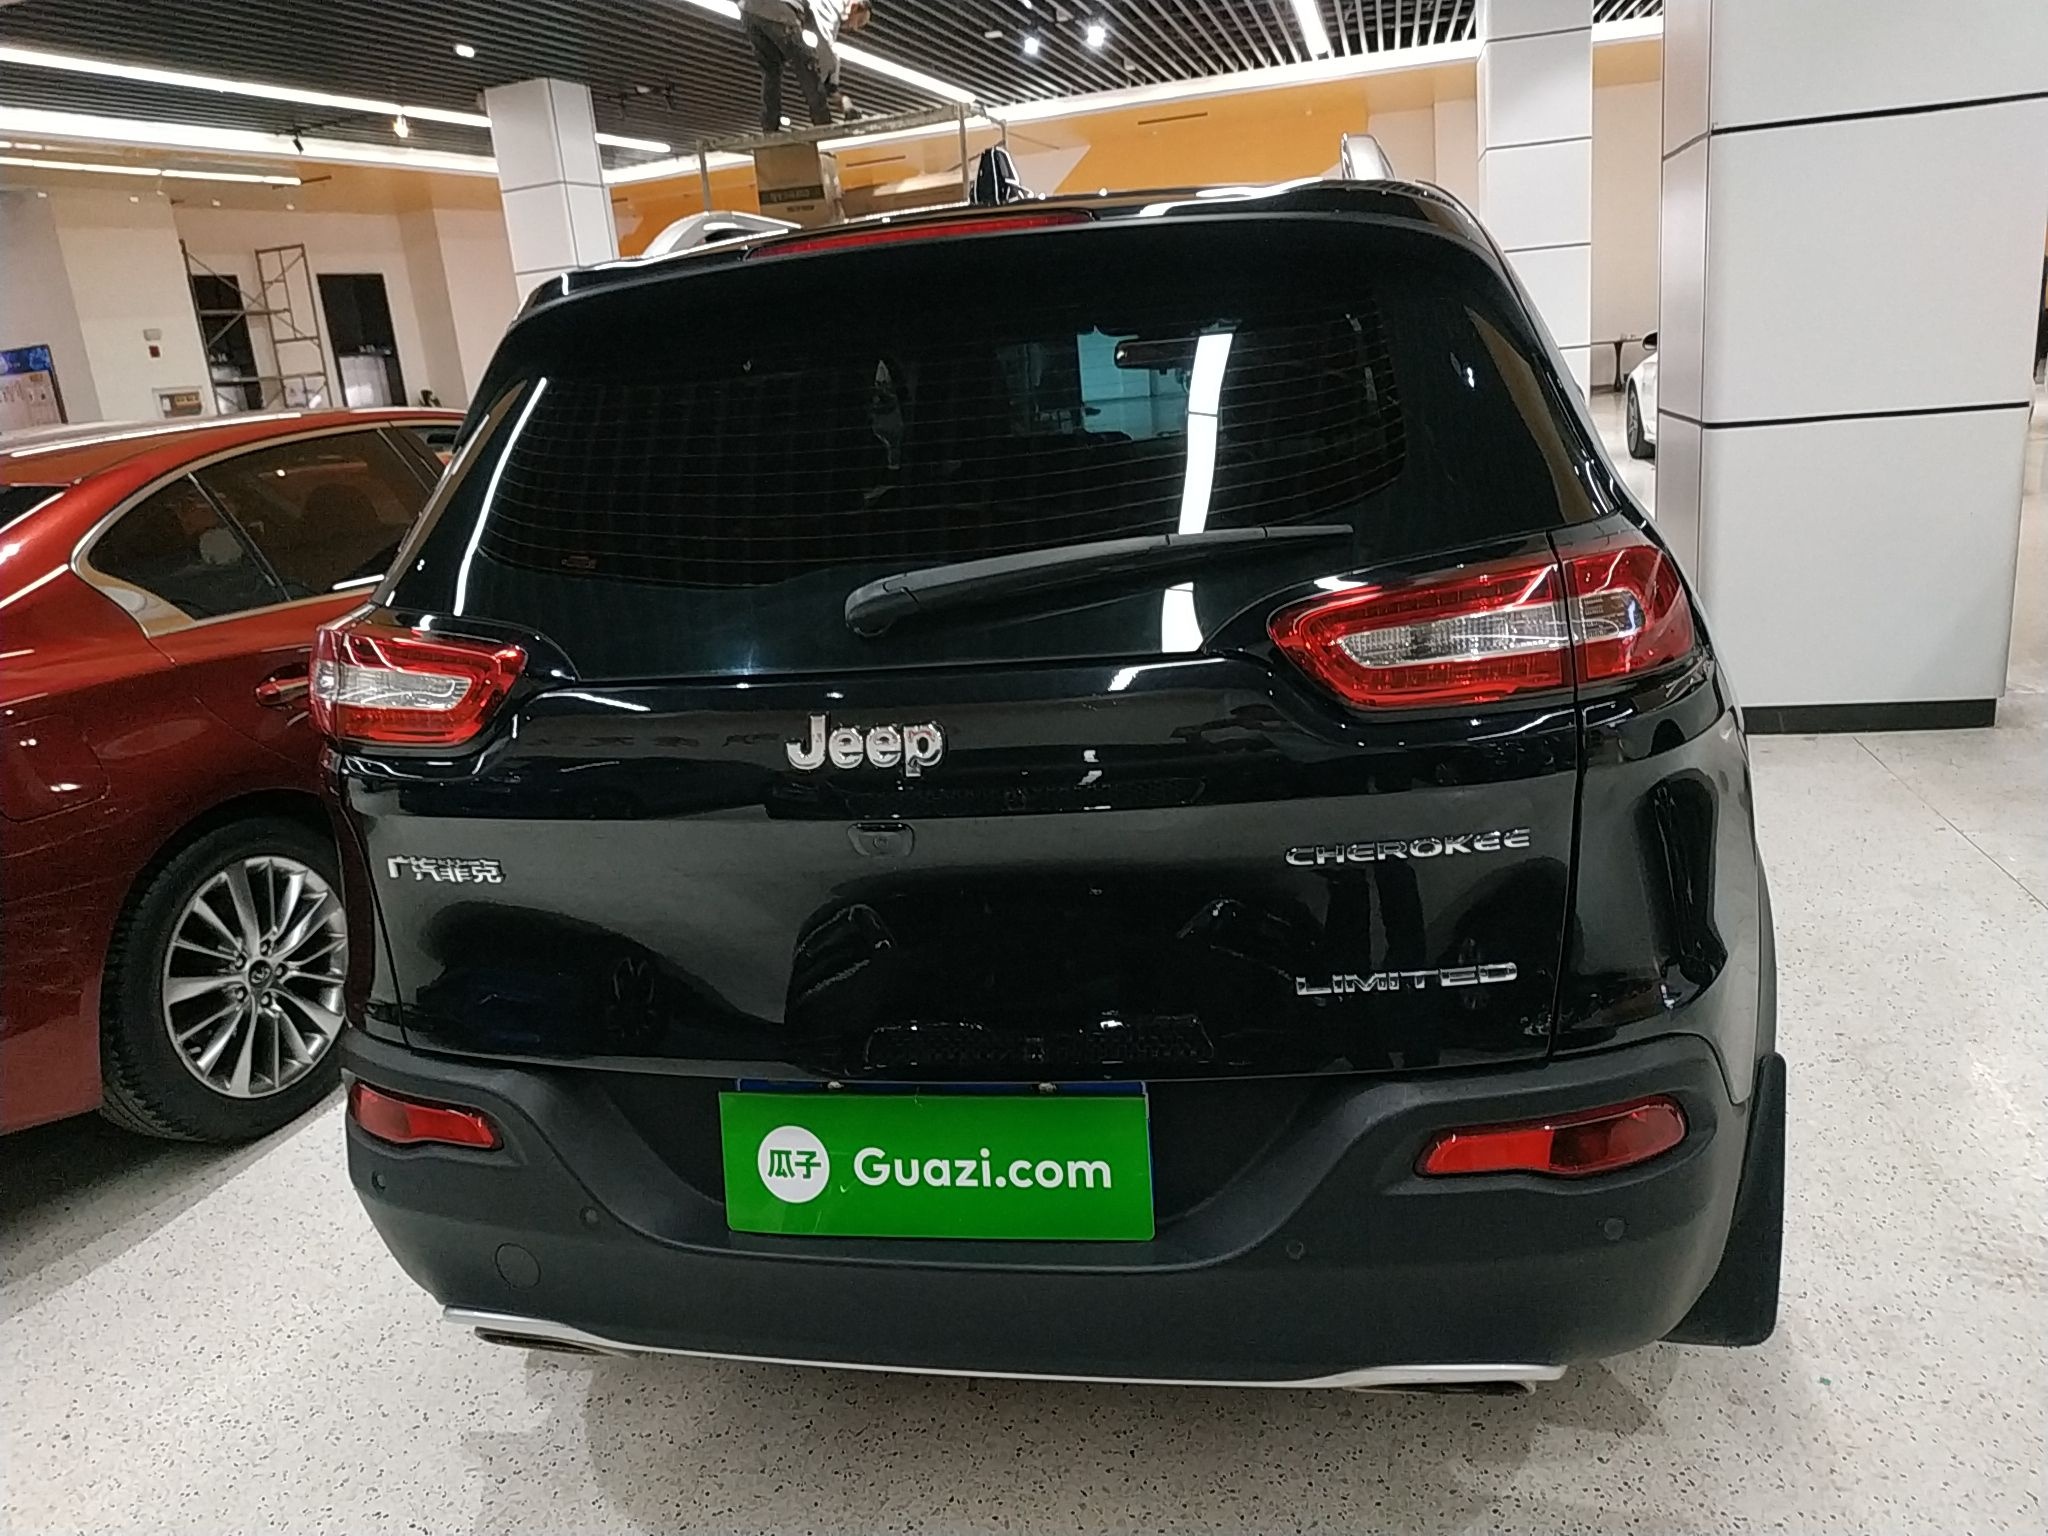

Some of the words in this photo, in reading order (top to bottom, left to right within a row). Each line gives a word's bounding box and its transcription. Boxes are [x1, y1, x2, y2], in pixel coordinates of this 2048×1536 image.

[786, 712, 944, 778] Jeep
[1285, 827, 1531, 867] CHEROKEE
[387, 856, 504, 884] 广汽菲克
[1295, 962, 1518, 996] LIMITED
[767, 1149, 822, 1180] 瓜子
[853, 1147, 1112, 1189] Guazi.com
